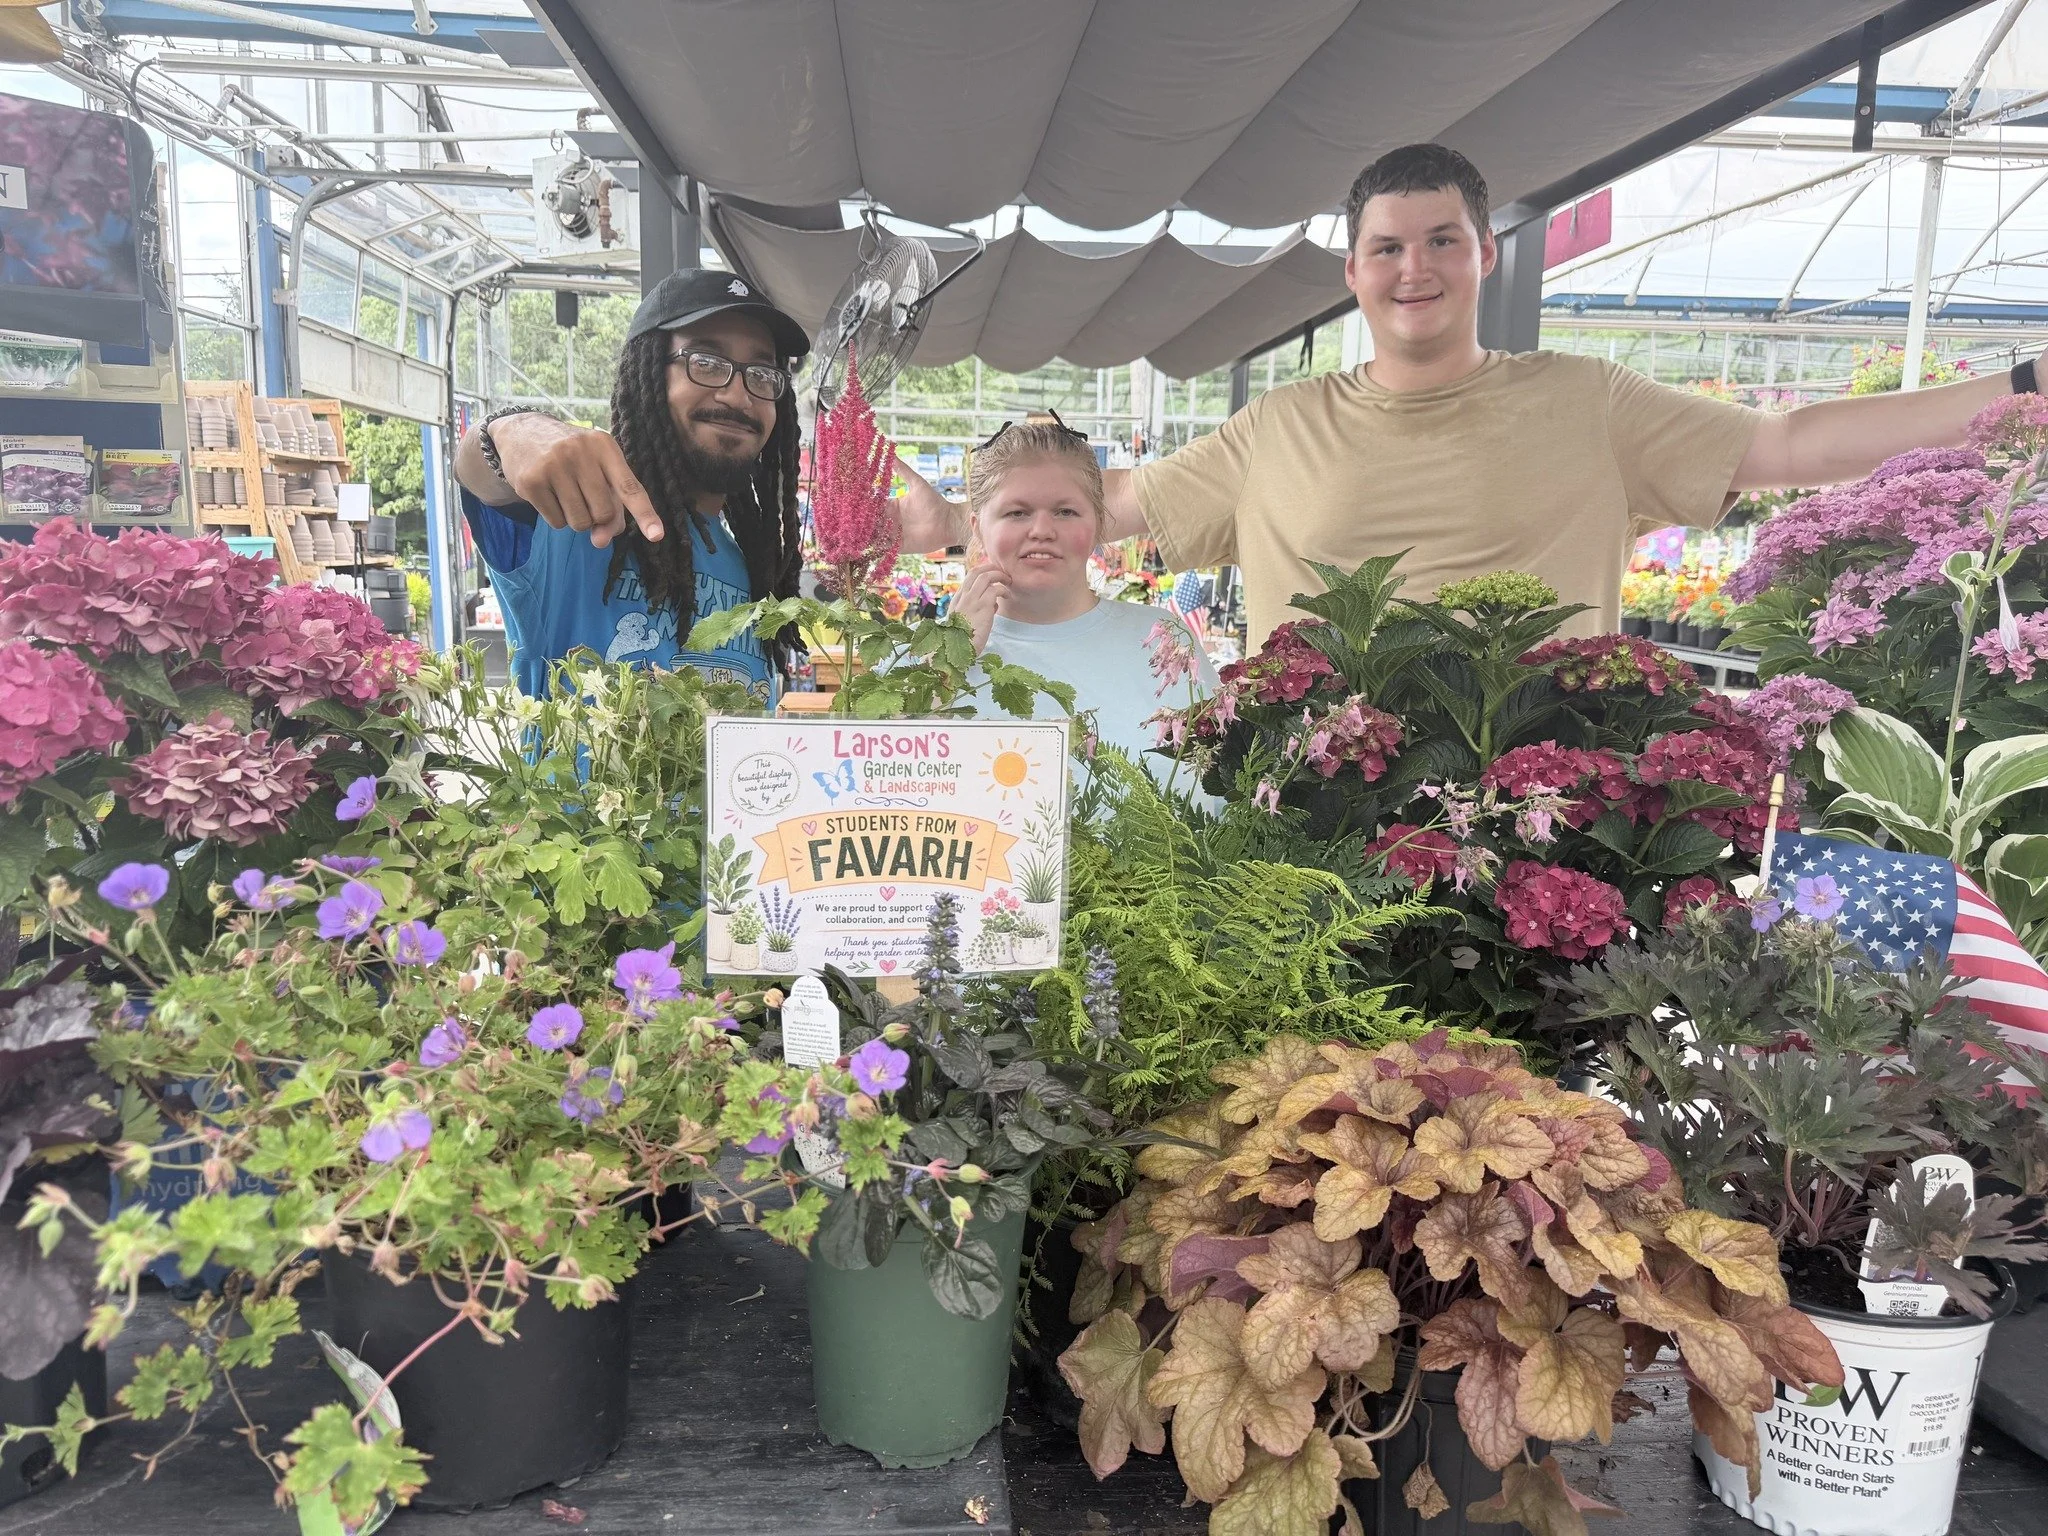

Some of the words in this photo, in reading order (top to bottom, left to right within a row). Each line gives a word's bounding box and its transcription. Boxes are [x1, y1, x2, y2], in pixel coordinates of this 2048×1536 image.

[754, 759, 771, 769] This
[863, 760, 912, 779] Garden
[917, 761, 962, 778] Center
[737, 771, 766, 783] beautiful
[768, 769, 792, 780] display
[759, 780, 788, 792] designed
[864, 780, 874, 793] &
[879, 779, 956, 796] Landscaping
[761, 792, 771, 804] by
[826, 815, 909, 834] STUDENTS
[915, 816, 957, 835] FROM
[807, 835, 973, 882] FAVARH
[815, 903, 830, 912] We
[832, 904, 847, 912] are
[849, 903, 876, 914] proud
[889, 904, 923, 914] support
[825, 915, 886, 925] collaboration,
[888, 915, 905, 924] and
[842, 936, 870, 947] Thank
[871, 939, 888, 949] you
[891, 936, 924, 946] student
[824, 947, 855, 960] helping
[857, 949, 872, 957] our
[873, 947, 903, 960] garden
[1892, 1284, 1923, 1292] Perennial
[1776, 1405, 1889, 1444] PROVEN
[1764, 1421, 1894, 1467] WINNERS
[1767, 1449, 1776, 1460] A
[1778, 1453, 1812, 1472] Better
[1815, 1463, 1859, 1482] Garden
[1862, 1472, 1895, 1485] Starts
[1778, 1468, 1801, 1484] with
[1803, 1477, 1811, 1486] a
[1815, 1479, 1850, 1495] Better
